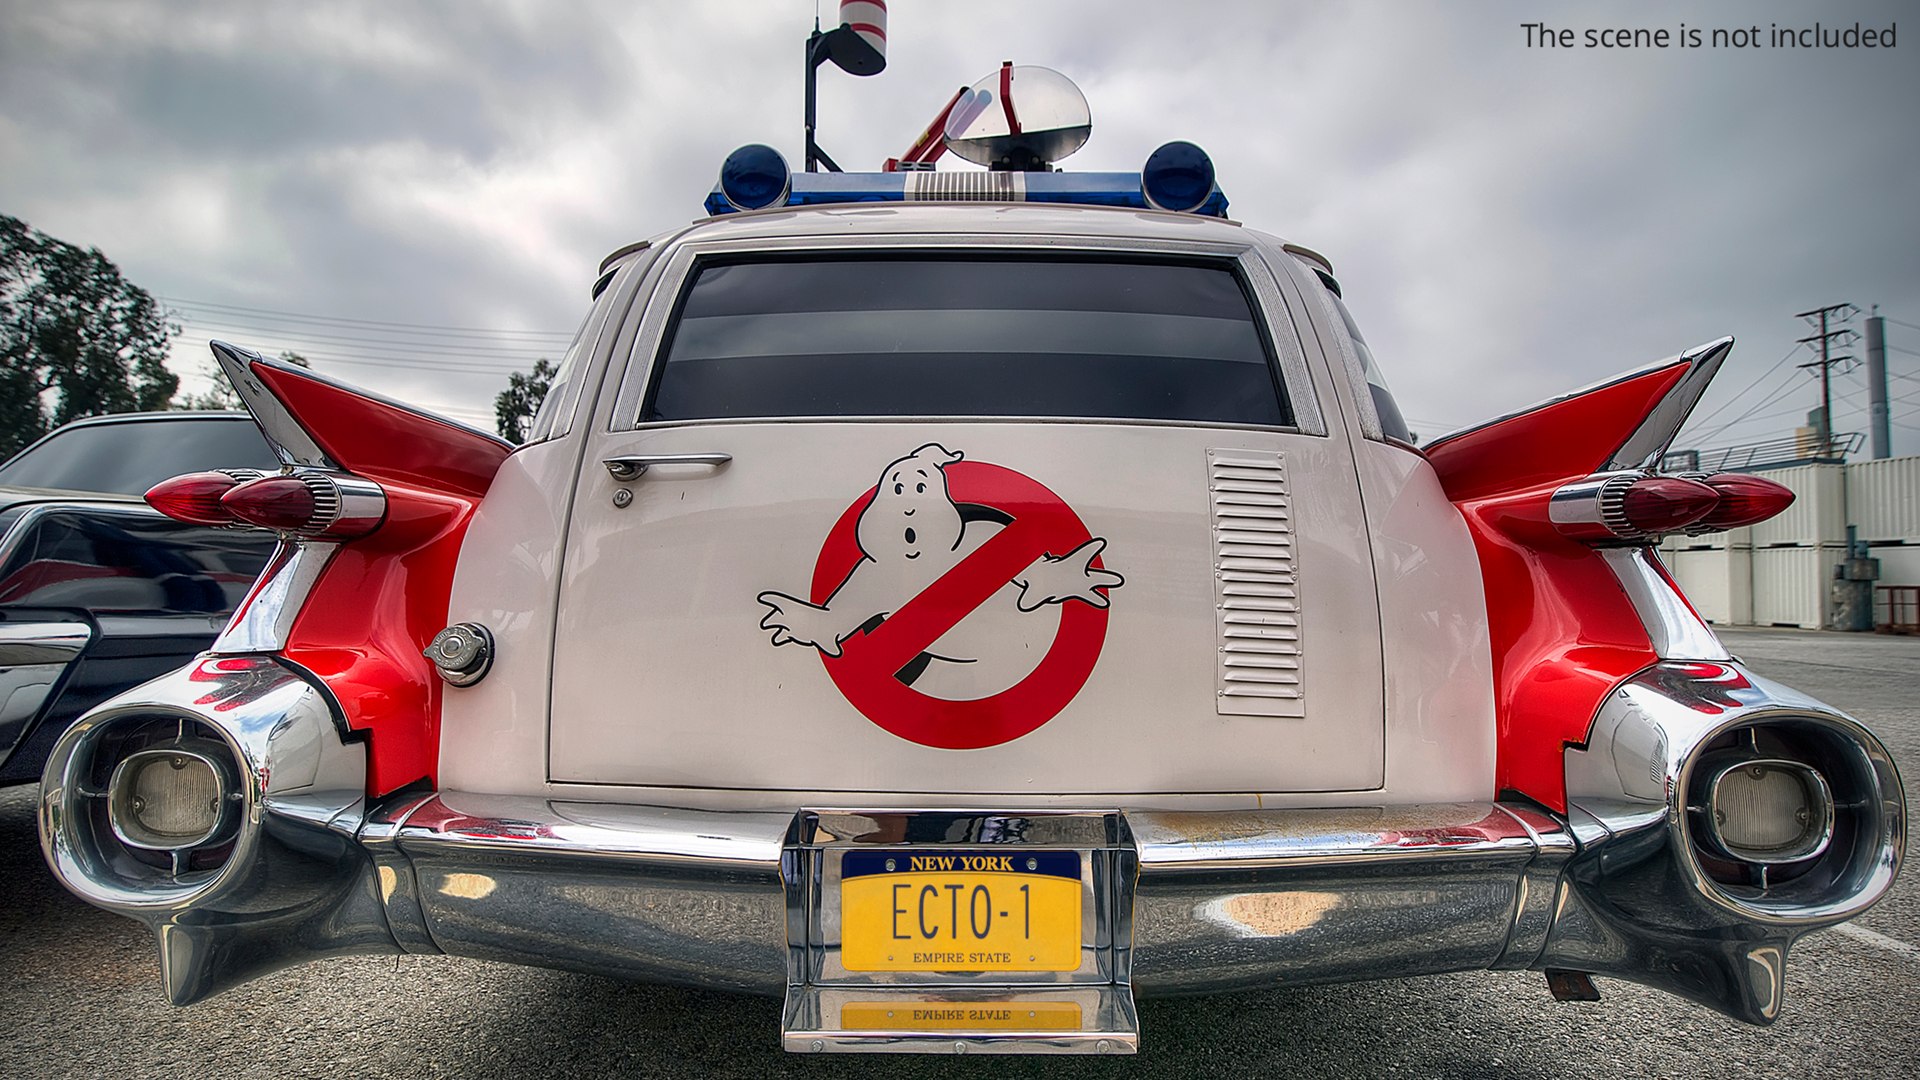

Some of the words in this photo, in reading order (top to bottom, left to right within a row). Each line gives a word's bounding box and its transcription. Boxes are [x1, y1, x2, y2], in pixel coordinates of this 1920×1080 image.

[909, 857, 957, 871] NEW
[959, 856, 1014, 871] YORK
[893, 884, 1030, 939] ECTO-1
[913, 952, 965, 963] EMPIRE
[969, 952, 1011, 963] STATE
